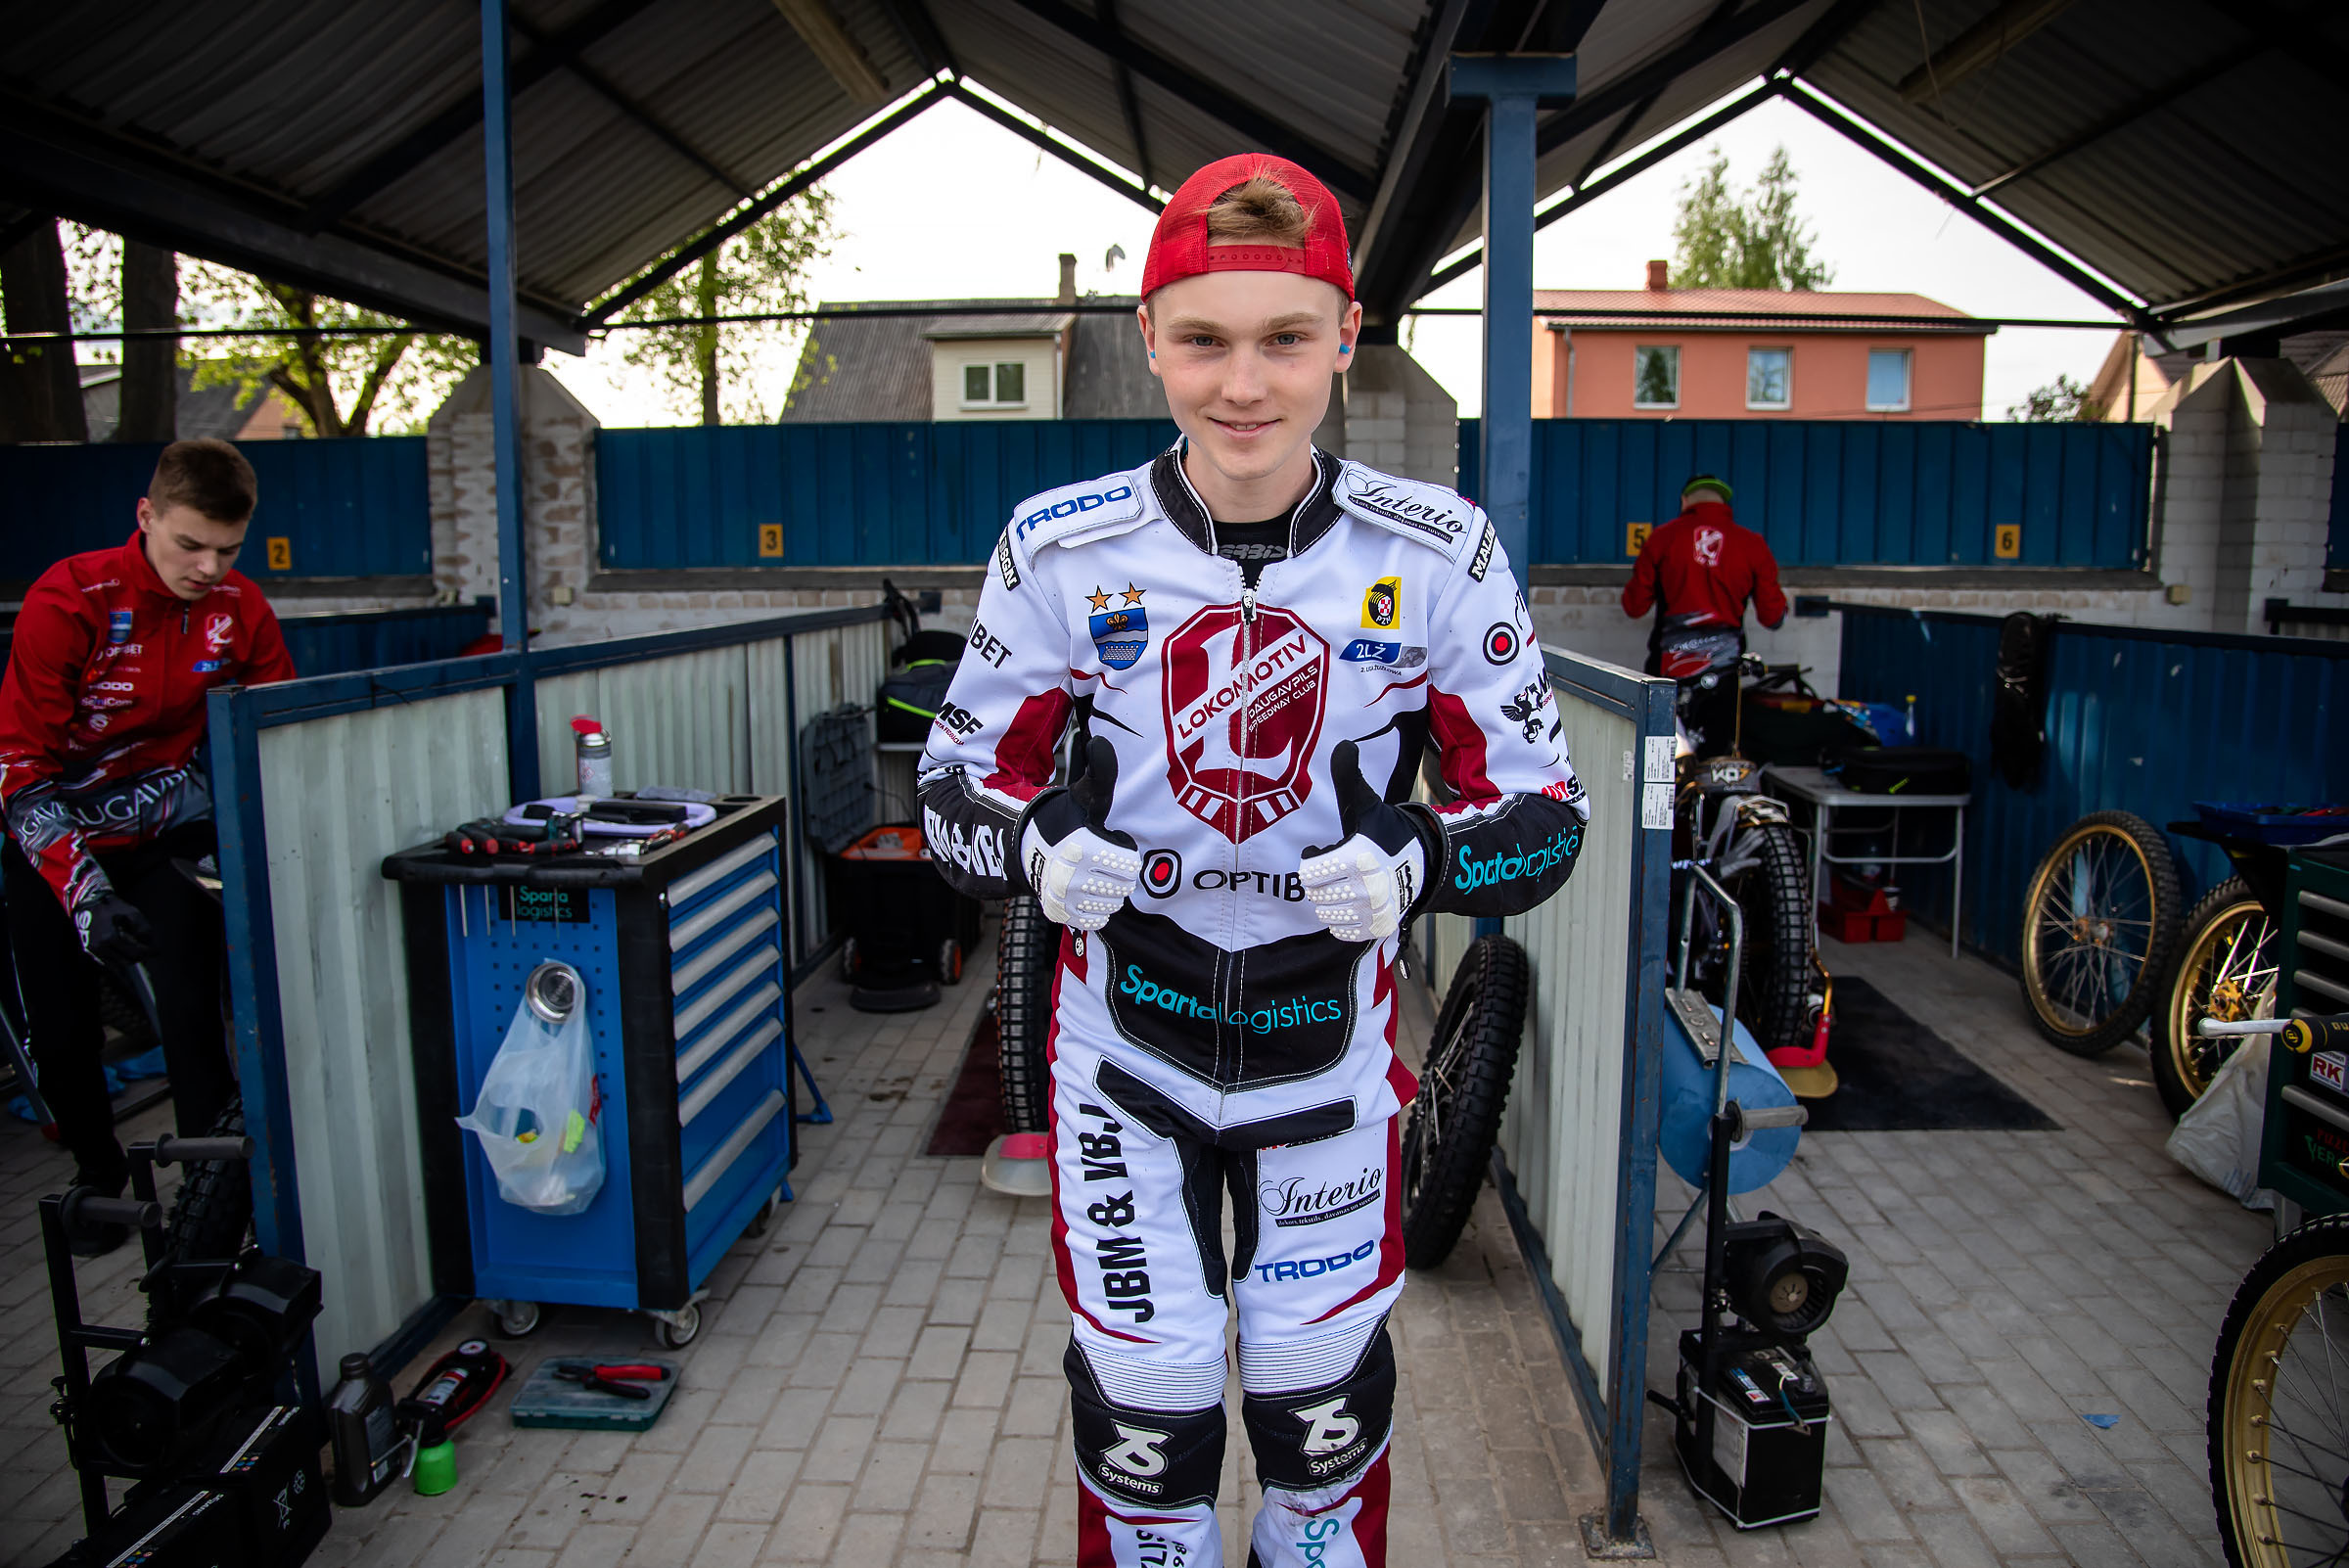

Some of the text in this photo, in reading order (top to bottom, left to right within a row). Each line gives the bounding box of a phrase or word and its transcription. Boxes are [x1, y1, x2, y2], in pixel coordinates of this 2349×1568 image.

[1016, 485, 1131, 542] TRODO
[1345, 469, 1466, 533] Interio
[273, 543, 285, 564] 2
[766, 530, 777, 550] 3
[1634, 528, 1644, 549] 5
[2003, 531, 2012, 550] 6
[1357, 643, 1387, 660] 2LŻ
[1177, 633, 1307, 740] LOKOMOTIV
[1249, 665, 1318, 719] DAUGAVPILS
[1249, 680, 1316, 733] SPEEDWAY CLUB
[1192, 869, 1310, 901] OPTIB
[2313, 1056, 2342, 1084] RK
[1259, 1167, 1385, 1216] Interio
[1078, 1103, 1155, 1323] JBM & VBJ
[1255, 1240, 1375, 1283] TRODO
[1311, 1442, 1366, 1473] Systems
[1101, 1465, 1161, 1495] Systems
